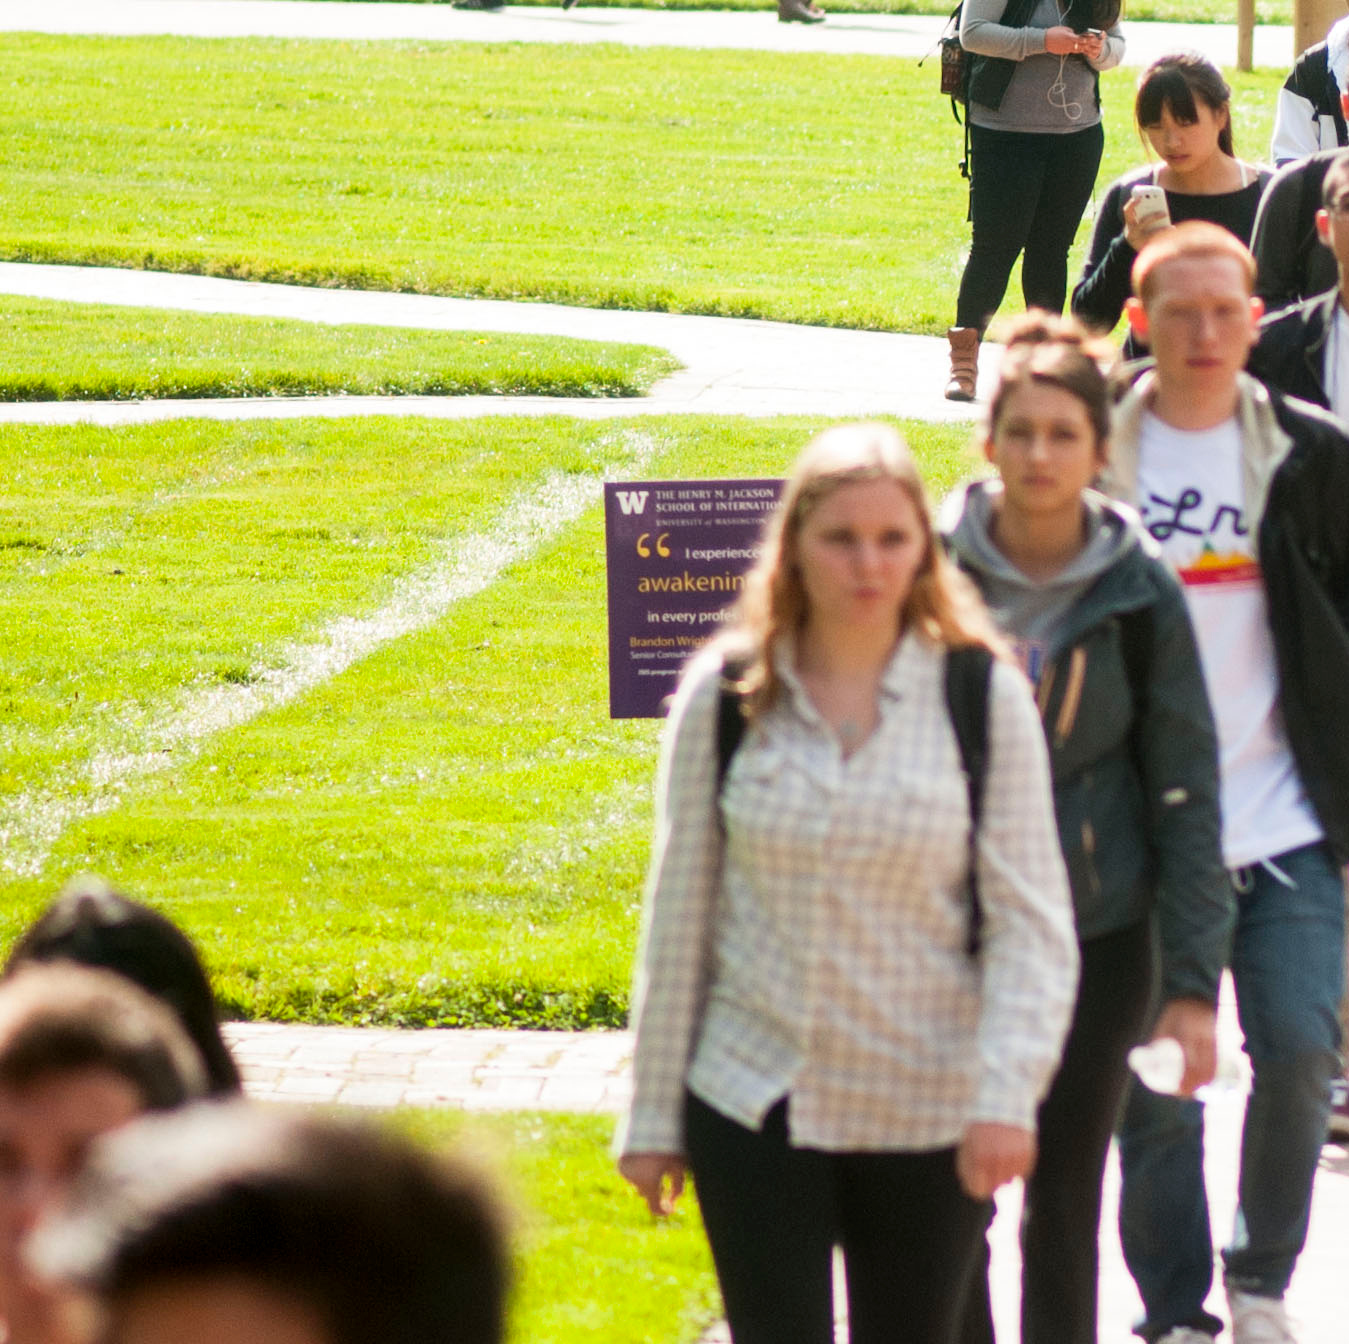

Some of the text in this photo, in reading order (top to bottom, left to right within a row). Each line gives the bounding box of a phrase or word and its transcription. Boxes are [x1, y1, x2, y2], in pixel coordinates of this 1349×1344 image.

[655, 488, 774, 500] THE HENRY M. JACKSON
[616, 491, 649, 515] W
[655, 502, 696, 512] SCHOOL
[699, 502, 713, 512] OF
[656, 519, 702, 527] UNIVERSITY
[637, 571, 746, 593] awakenin
[647, 611, 659, 623] in
[662, 611, 699, 625] every
[629, 636, 675, 647] Brandon
[630, 651, 655, 659] Senior
